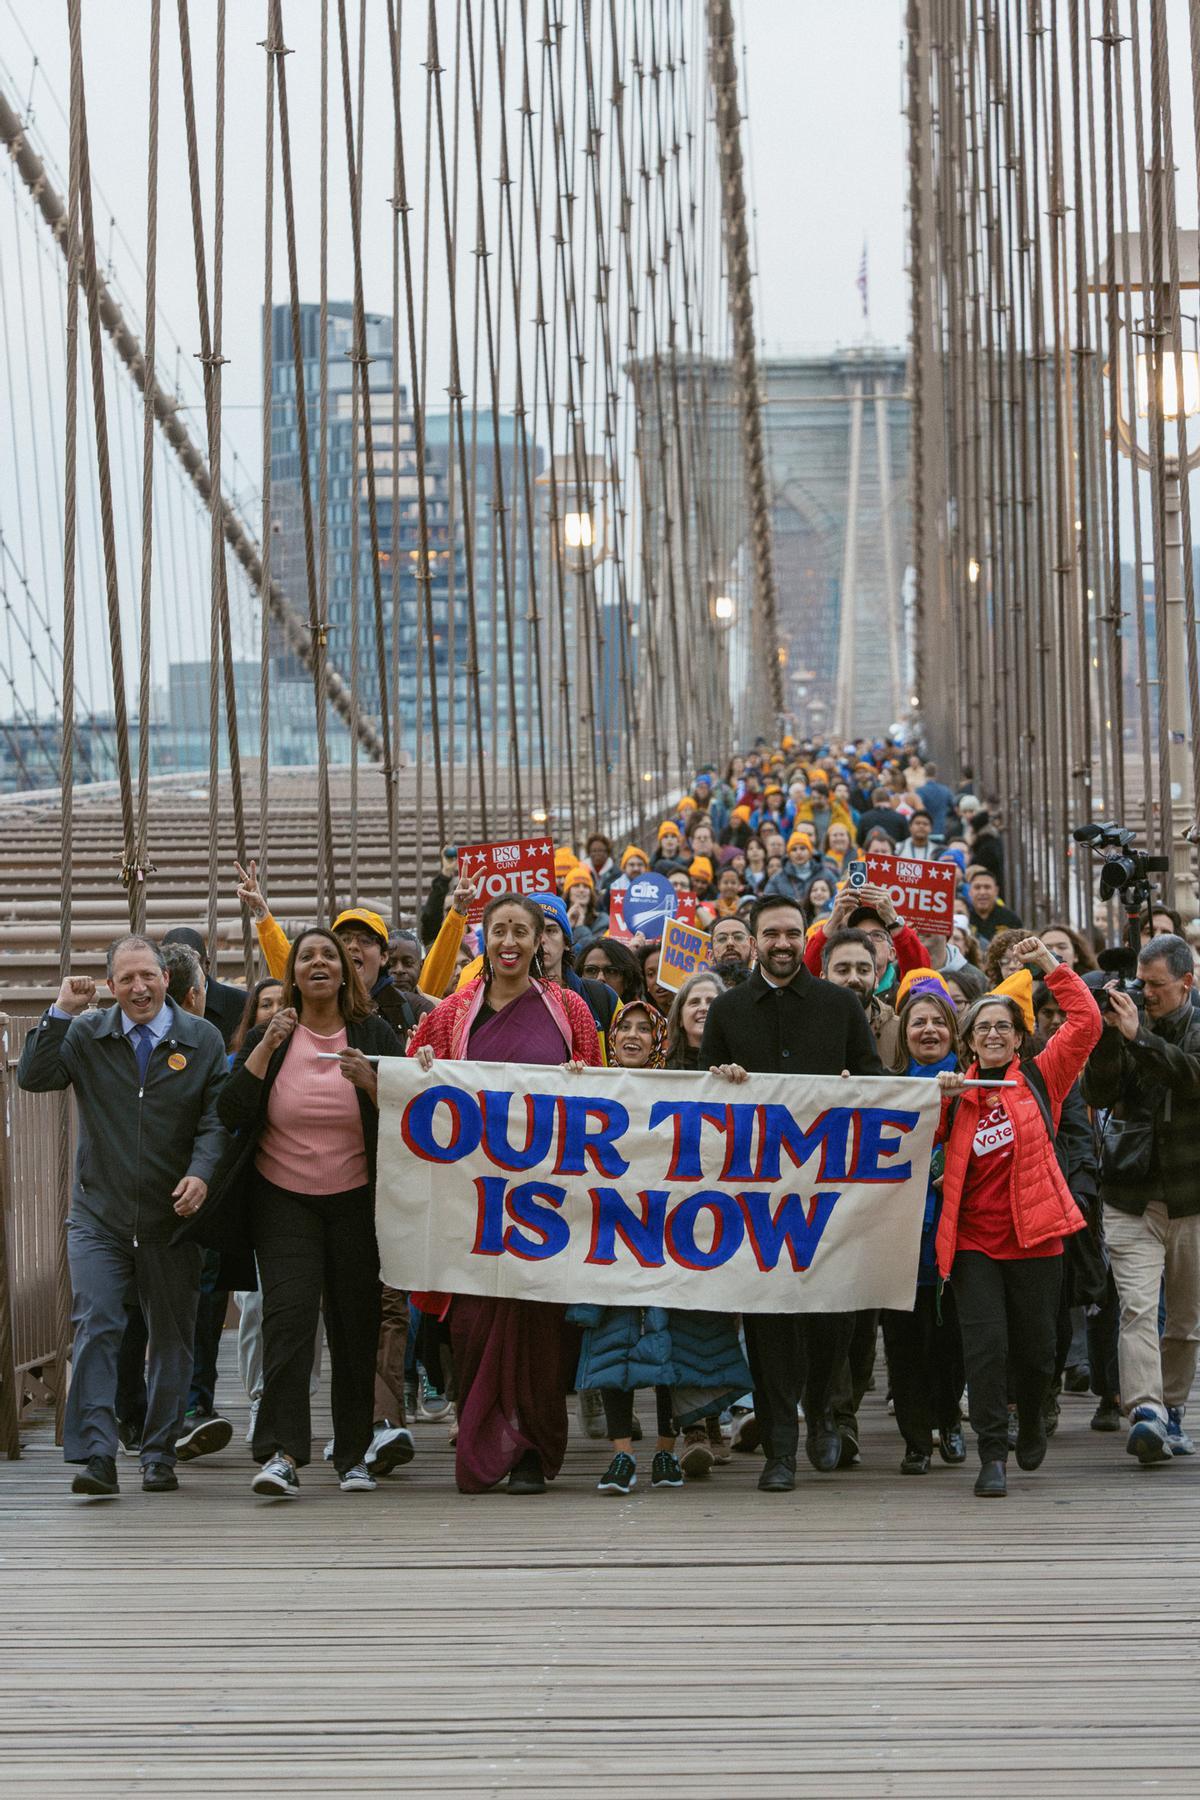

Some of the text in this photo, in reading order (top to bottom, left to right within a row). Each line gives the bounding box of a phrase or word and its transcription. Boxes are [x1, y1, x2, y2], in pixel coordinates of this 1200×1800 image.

[494, 846, 519, 861] PSC
[496, 861, 518, 870] CUNY
[899, 862, 922, 877] PSC
[899, 876, 919, 885] CUNY
[869, 882, 947, 913] OTES
[670, 928, 702, 955] OUR
[665, 946, 695, 973] HAS
[401, 1085, 920, 1184] OUR TIME
[976, 1127, 1012, 1148] Vote
[471, 1176, 842, 1272] IS NOW
